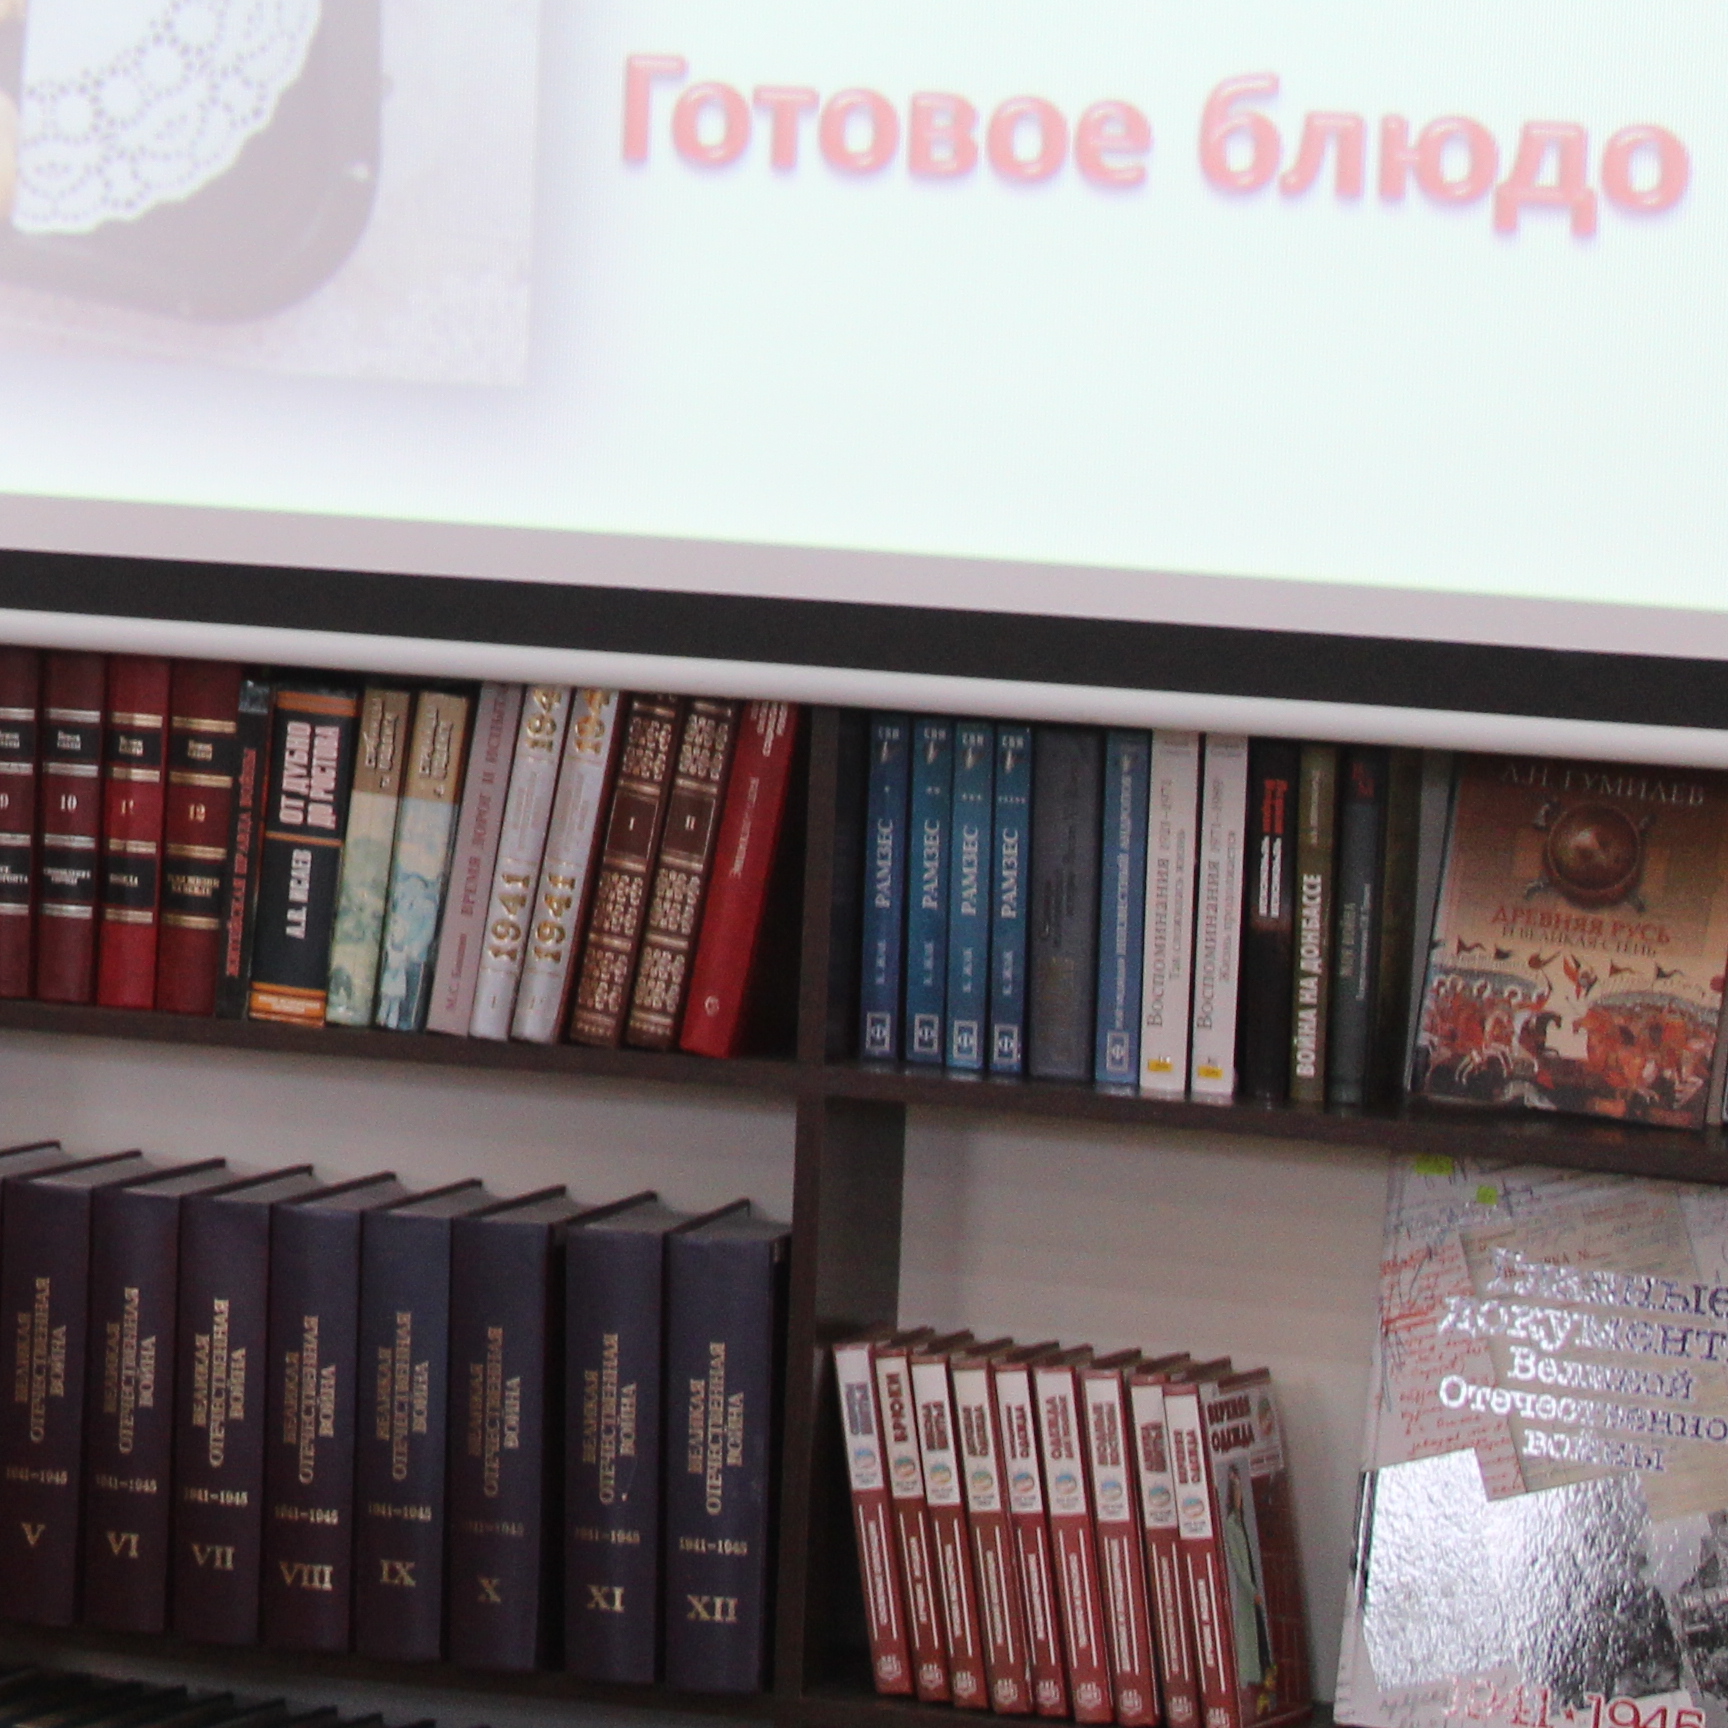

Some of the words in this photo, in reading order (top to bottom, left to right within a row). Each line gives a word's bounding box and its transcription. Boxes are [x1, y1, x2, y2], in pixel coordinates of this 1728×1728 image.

[620, 52, 1154, 191] Готовое
[1195, 71, 1694, 240] блюдо
[282, 720, 312, 795] ДУБНО
[310, 725, 341, 801] РОСТОВА
[1563, 769, 1706, 806] ГУМИЛЕВ
[59, 793, 78, 811] 10
[188, 803, 207, 823] 12
[279, 795, 305, 826] ОТ
[307, 802, 336, 830] ДО
[234, 812, 253, 875] ПРАВДА
[288, 848, 312, 902] ИСАЕВ
[460, 856, 481, 916] ВРЕМЯ
[482, 772, 494, 785] И
[874, 817, 894, 909] РАМЗЕС
[921, 818, 941, 911] РАМЗЕС
[960, 824, 979, 917] РАМЗЕС
[1000, 827, 1019, 920] РАМЗЕС
[487, 872, 531, 963] 1941
[532, 872, 576, 964] 1941
[1146, 857, 1171, 1028] Воспоминания
[1196, 860, 1220, 1030] Воспоминания
[1300, 873, 1324, 975] ДОНБАССЕ
[1491, 905, 1604, 937] ДРЕВНЯЯ
[1611, 920, 1672, 945] РУСЬ
[1299, 976, 1319, 1005] НА
[1294, 1007, 1318, 1078] ВОЙНА
[15, 1312, 32, 1404] ВЕЛИКАЯ
[29, 1276, 51, 1444] ОТЕЧЕСТВЕННАЯ
[49, 1324, 67, 1397] ВОЙНА
[103, 1321, 121, 1414] ВЕЛИКАЯ
[1437, 1295, 1728, 1364] документ
[117, 1286, 140, 1455] ОТЕЧЕСТВЕННАЯ
[138, 1335, 157, 1408] ВОЙНА
[191, 1333, 211, 1429] ВЕЛИКАЯ
[208, 1297, 230, 1469] ОТЕЧЕСТВЕННАЯ
[228, 1346, 247, 1421] ВОЙНА
[282, 1351, 301, 1446] ВЕЛИКАЯ
[297, 1314, 320, 1486] ОТЕЧЕСТВЕННАЯ
[318, 1363, 337, 1439] ВОЙНА
[375, 1346, 393, 1441] ВЕЛИКАЯ
[391, 1311, 413, 1482] ОТЕЧЕСТВЕННАЯ
[411, 1359, 430, 1435] ВОЙНА
[885, 1372, 908, 1443] БРЮКИ
[1438, 1374, 1728, 1443] Отечественно
[1506, 1345, 1697, 1402] Великой
[467, 1362, 485, 1458] ВЕЛИКАЯ
[483, 1326, 504, 1498] ОТЕЧЕСТВЕННАЯ
[503, 1375, 522, 1450] ВОЙНА
[582, 1369, 600, 1465] ВЕЛИКАЯ
[599, 1332, 620, 1505] ОТЕЧЕСТВЕННАЯ
[619, 1382, 638, 1457] ВОЙНА
[687, 1377, 706, 1475] ВЕЛИКАЯ
[705, 1341, 726, 1516] ОТЕЧЕСТВЕННАЯ
[725, 1390, 745, 1467] ВОЙНА
[1522, 1428, 1666, 1472] войны
[21, 1521, 45, 1547] V
[106, 1530, 140, 1559] VI
[191, 1543, 235, 1570] VII
[279, 1562, 334, 1592] VIII
[379, 1559, 417, 1588] IX
[477, 1577, 502, 1604] X
[586, 1584, 626, 1614] XI
[685, 1593, 739, 1624] XII
